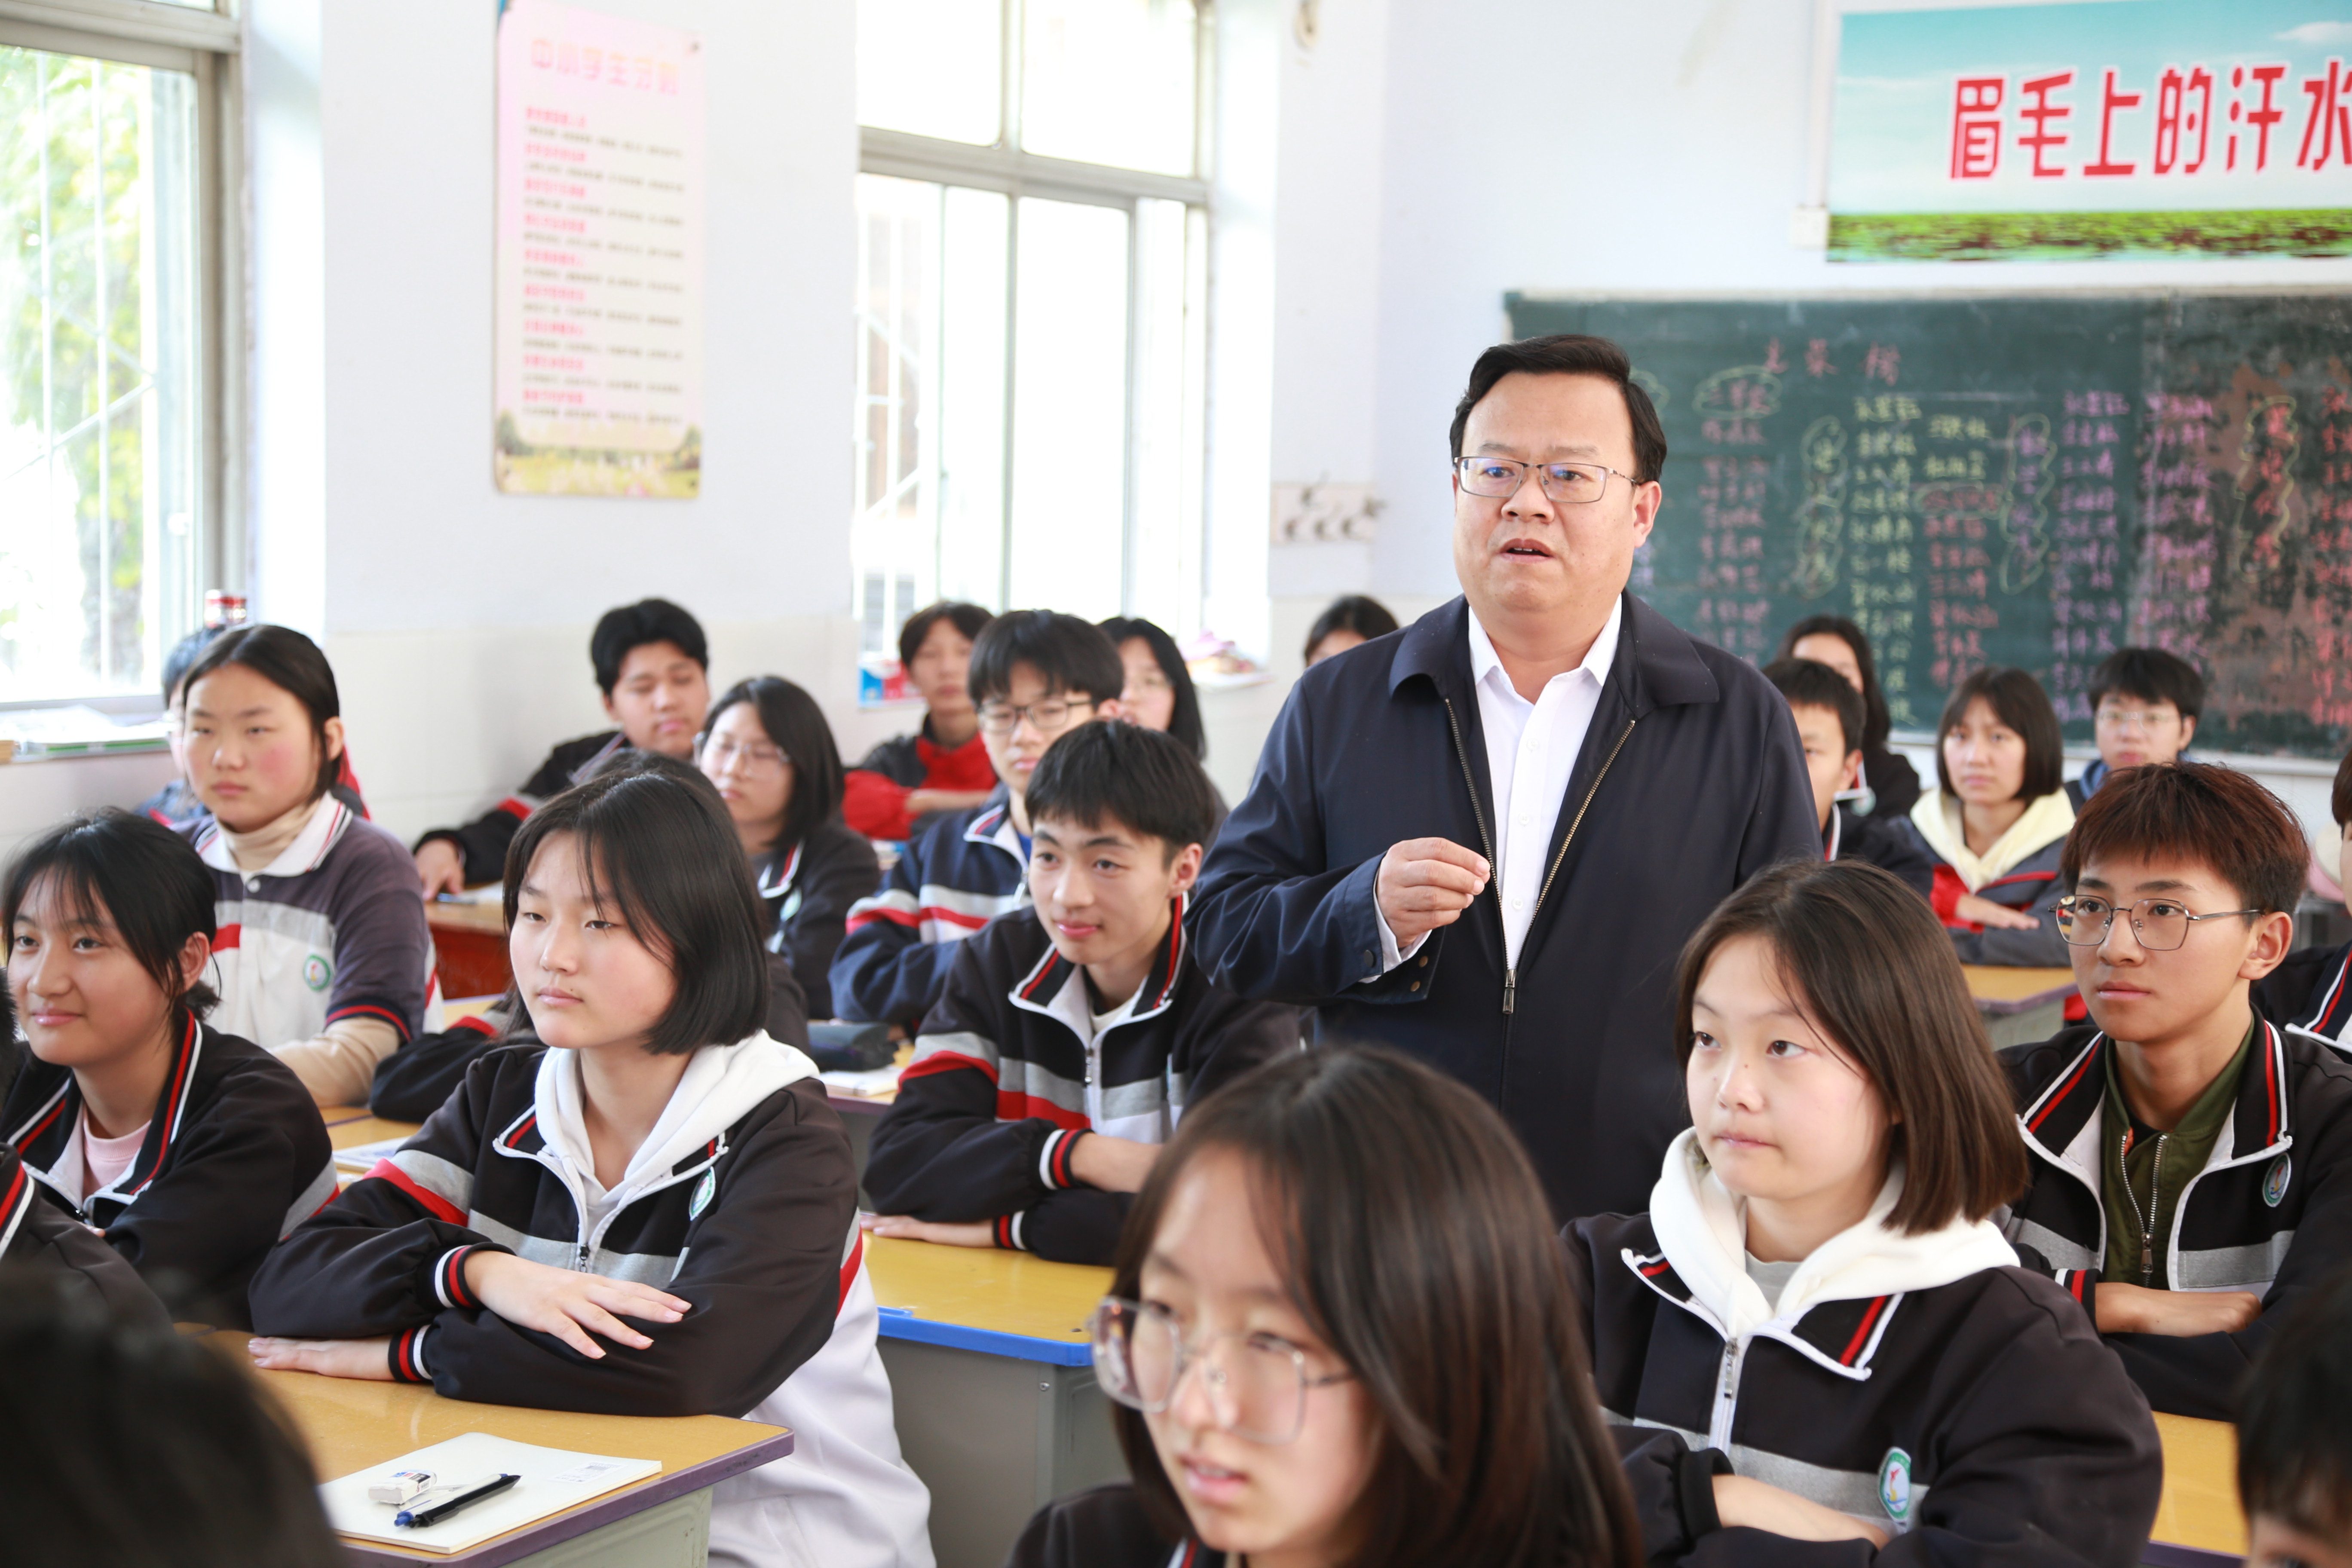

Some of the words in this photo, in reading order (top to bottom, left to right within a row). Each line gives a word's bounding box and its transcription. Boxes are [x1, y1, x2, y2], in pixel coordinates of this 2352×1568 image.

[1950, 61, 2352, 179] 眉毛上的汗水
